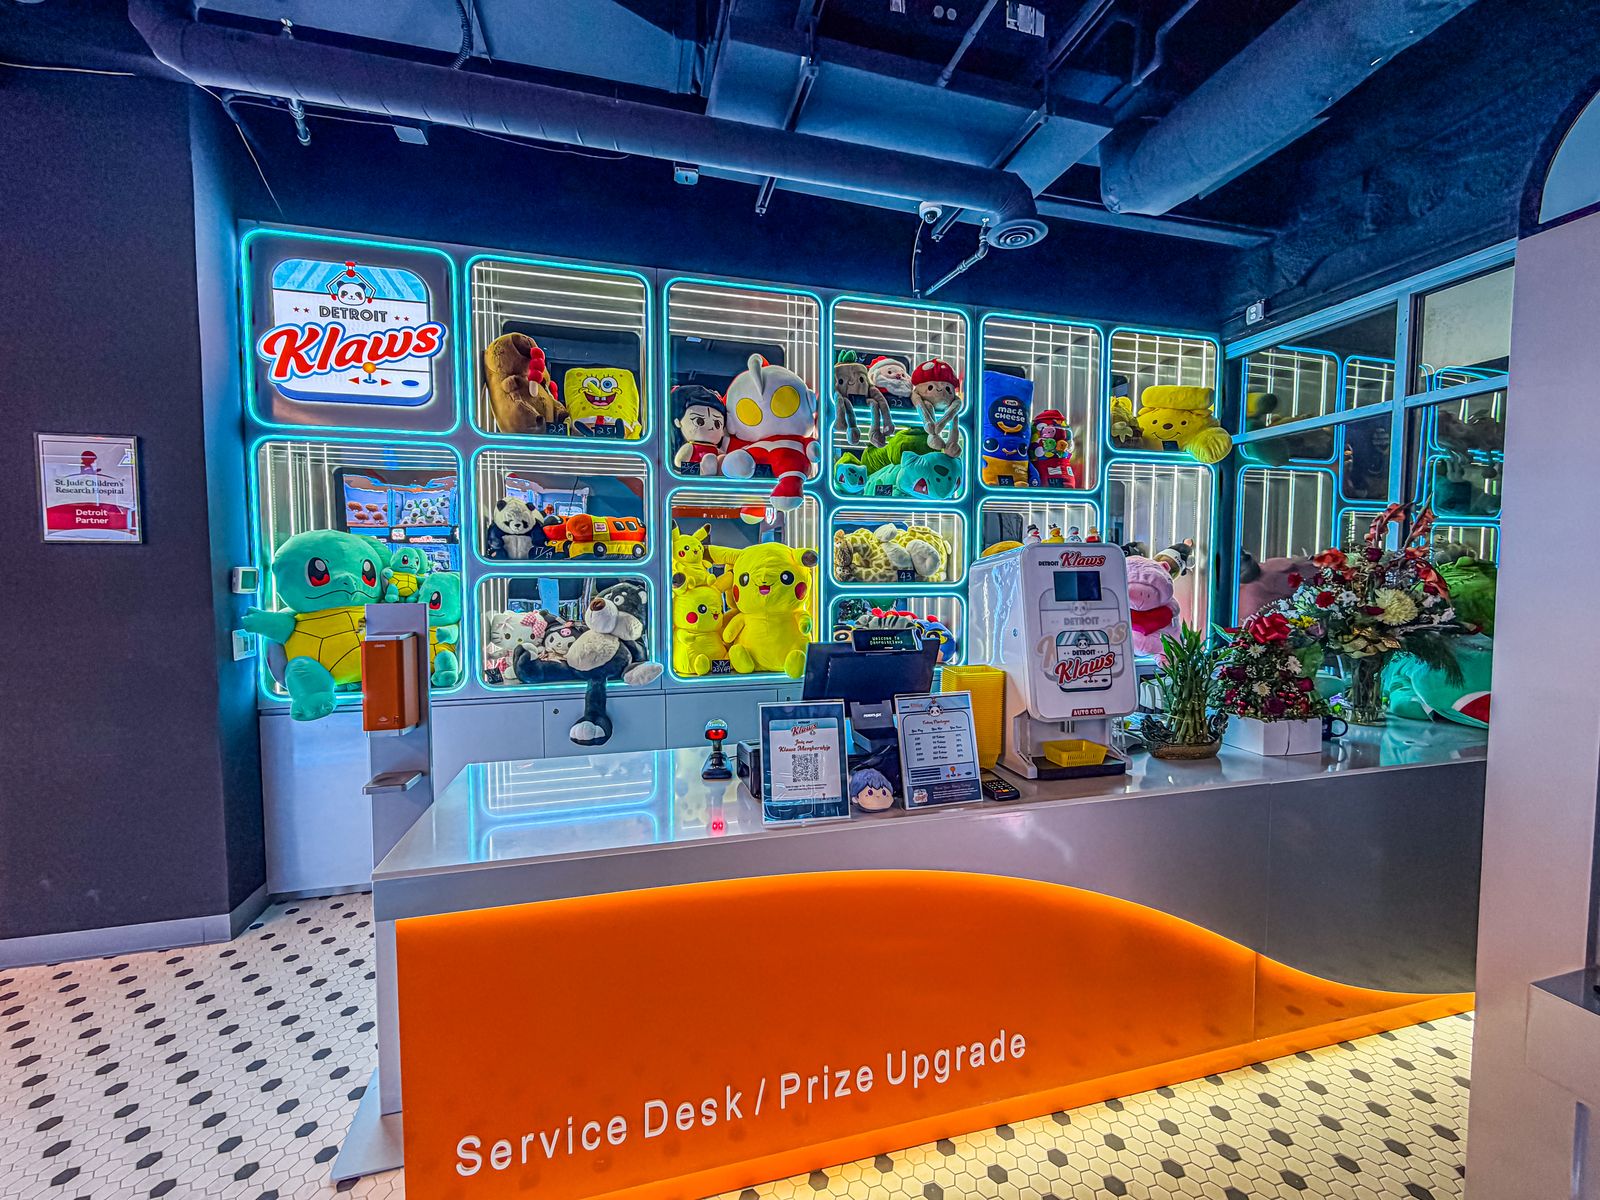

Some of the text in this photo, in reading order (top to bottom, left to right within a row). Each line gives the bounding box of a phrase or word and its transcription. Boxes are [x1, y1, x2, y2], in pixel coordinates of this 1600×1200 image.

[319, 305, 388, 323] DETROIT
[261, 325, 442, 380] Klaws
[998, 406, 1016, 414] mac
[66, 479, 84, 487] Jude
[85, 479, 124, 487] Children's
[1060, 551, 1106, 568] Klaws
[1064, 616, 1099, 626] DETROIT
[1055, 653, 1115, 686] Klaws
[455, 1029, 1026, 1177] Service Desk / Prize Upgrade
